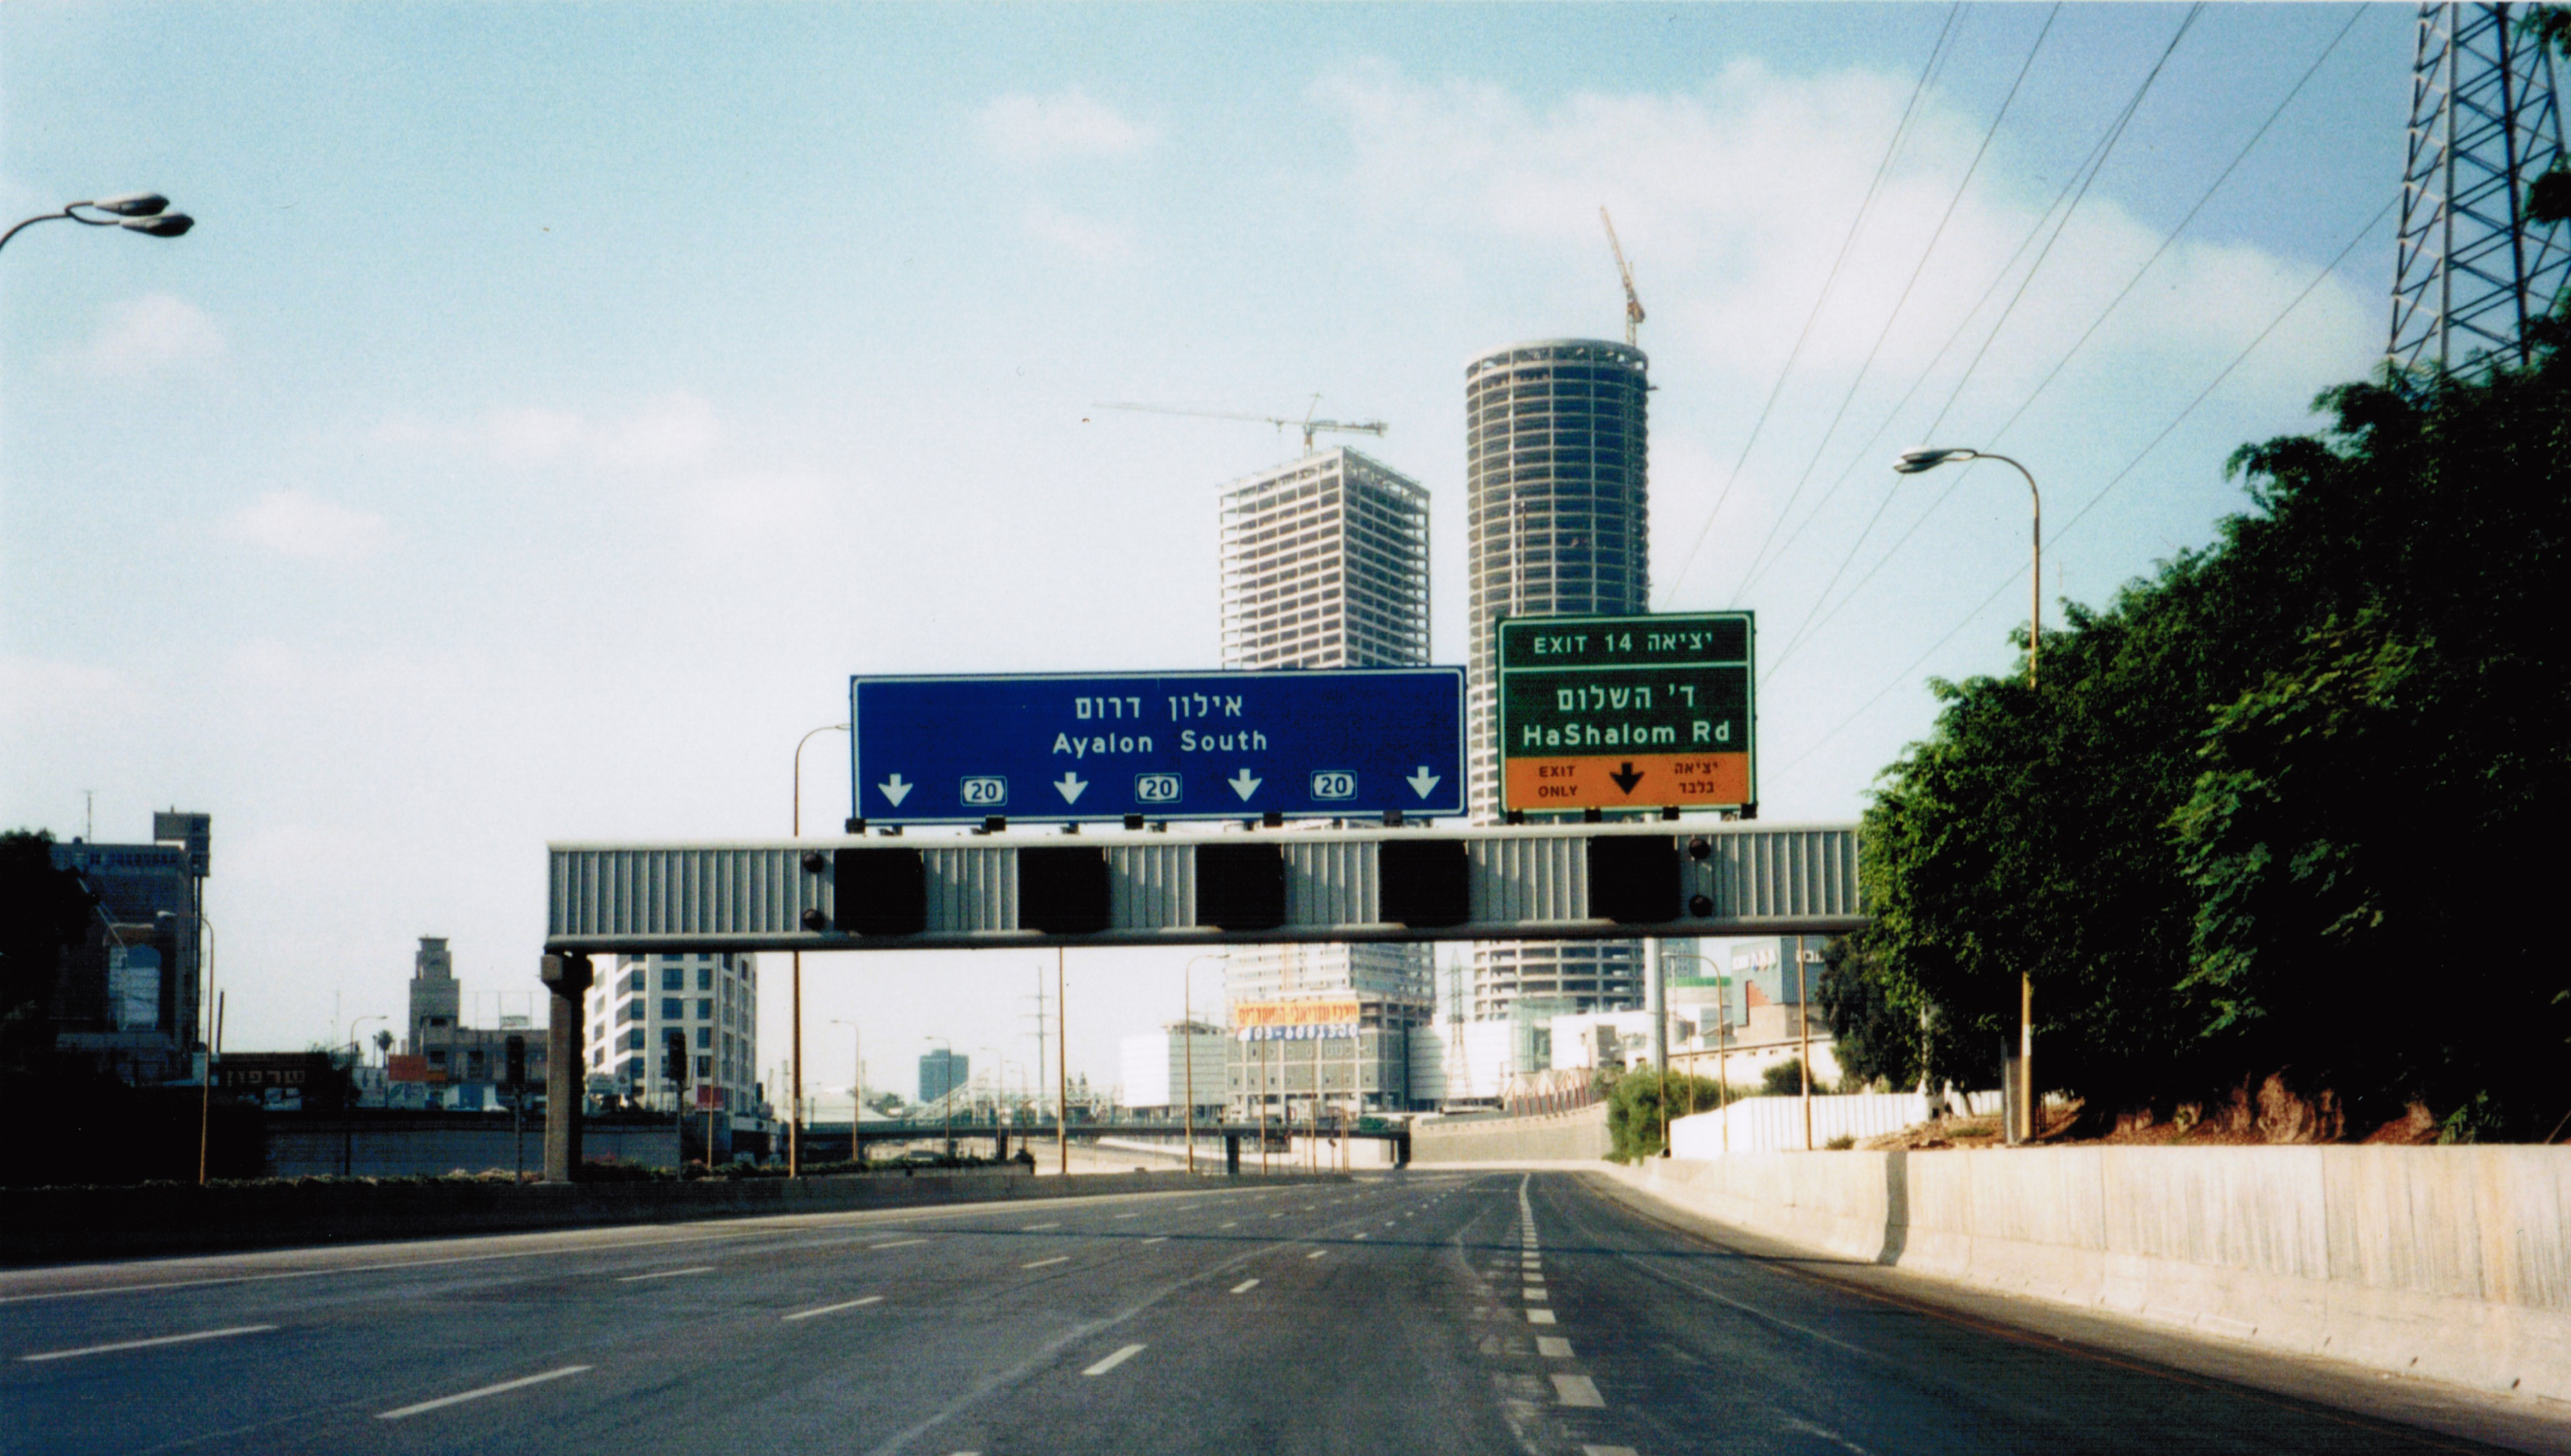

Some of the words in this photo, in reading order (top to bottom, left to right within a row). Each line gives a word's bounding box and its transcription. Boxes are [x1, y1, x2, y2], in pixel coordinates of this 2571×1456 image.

[1533, 635, 1587, 654] EXIT
[1605, 633, 1632, 652] 14
[1647, 632, 1713, 652] יציאה
[1168, 692, 1243, 721] אילון
[1557, 685, 1651, 711] השלום
[1075, 697, 1141, 719] דרום
[1523, 723, 1676, 746] HaShalom
[1692, 721, 1730, 742] Rd
[1053, 732, 1153, 759] Ayalon
[1181, 729, 1267, 751] South
[1539, 765, 1576, 778] EXIT
[1674, 762, 1718, 774] יציאה
[971, 782, 997, 800] 20
[1145, 780, 1172, 797] 20
[1321, 777, 1348, 795] 20
[1538, 785, 1578, 798] ONLY
[1679, 781, 1715, 794] בלבד
